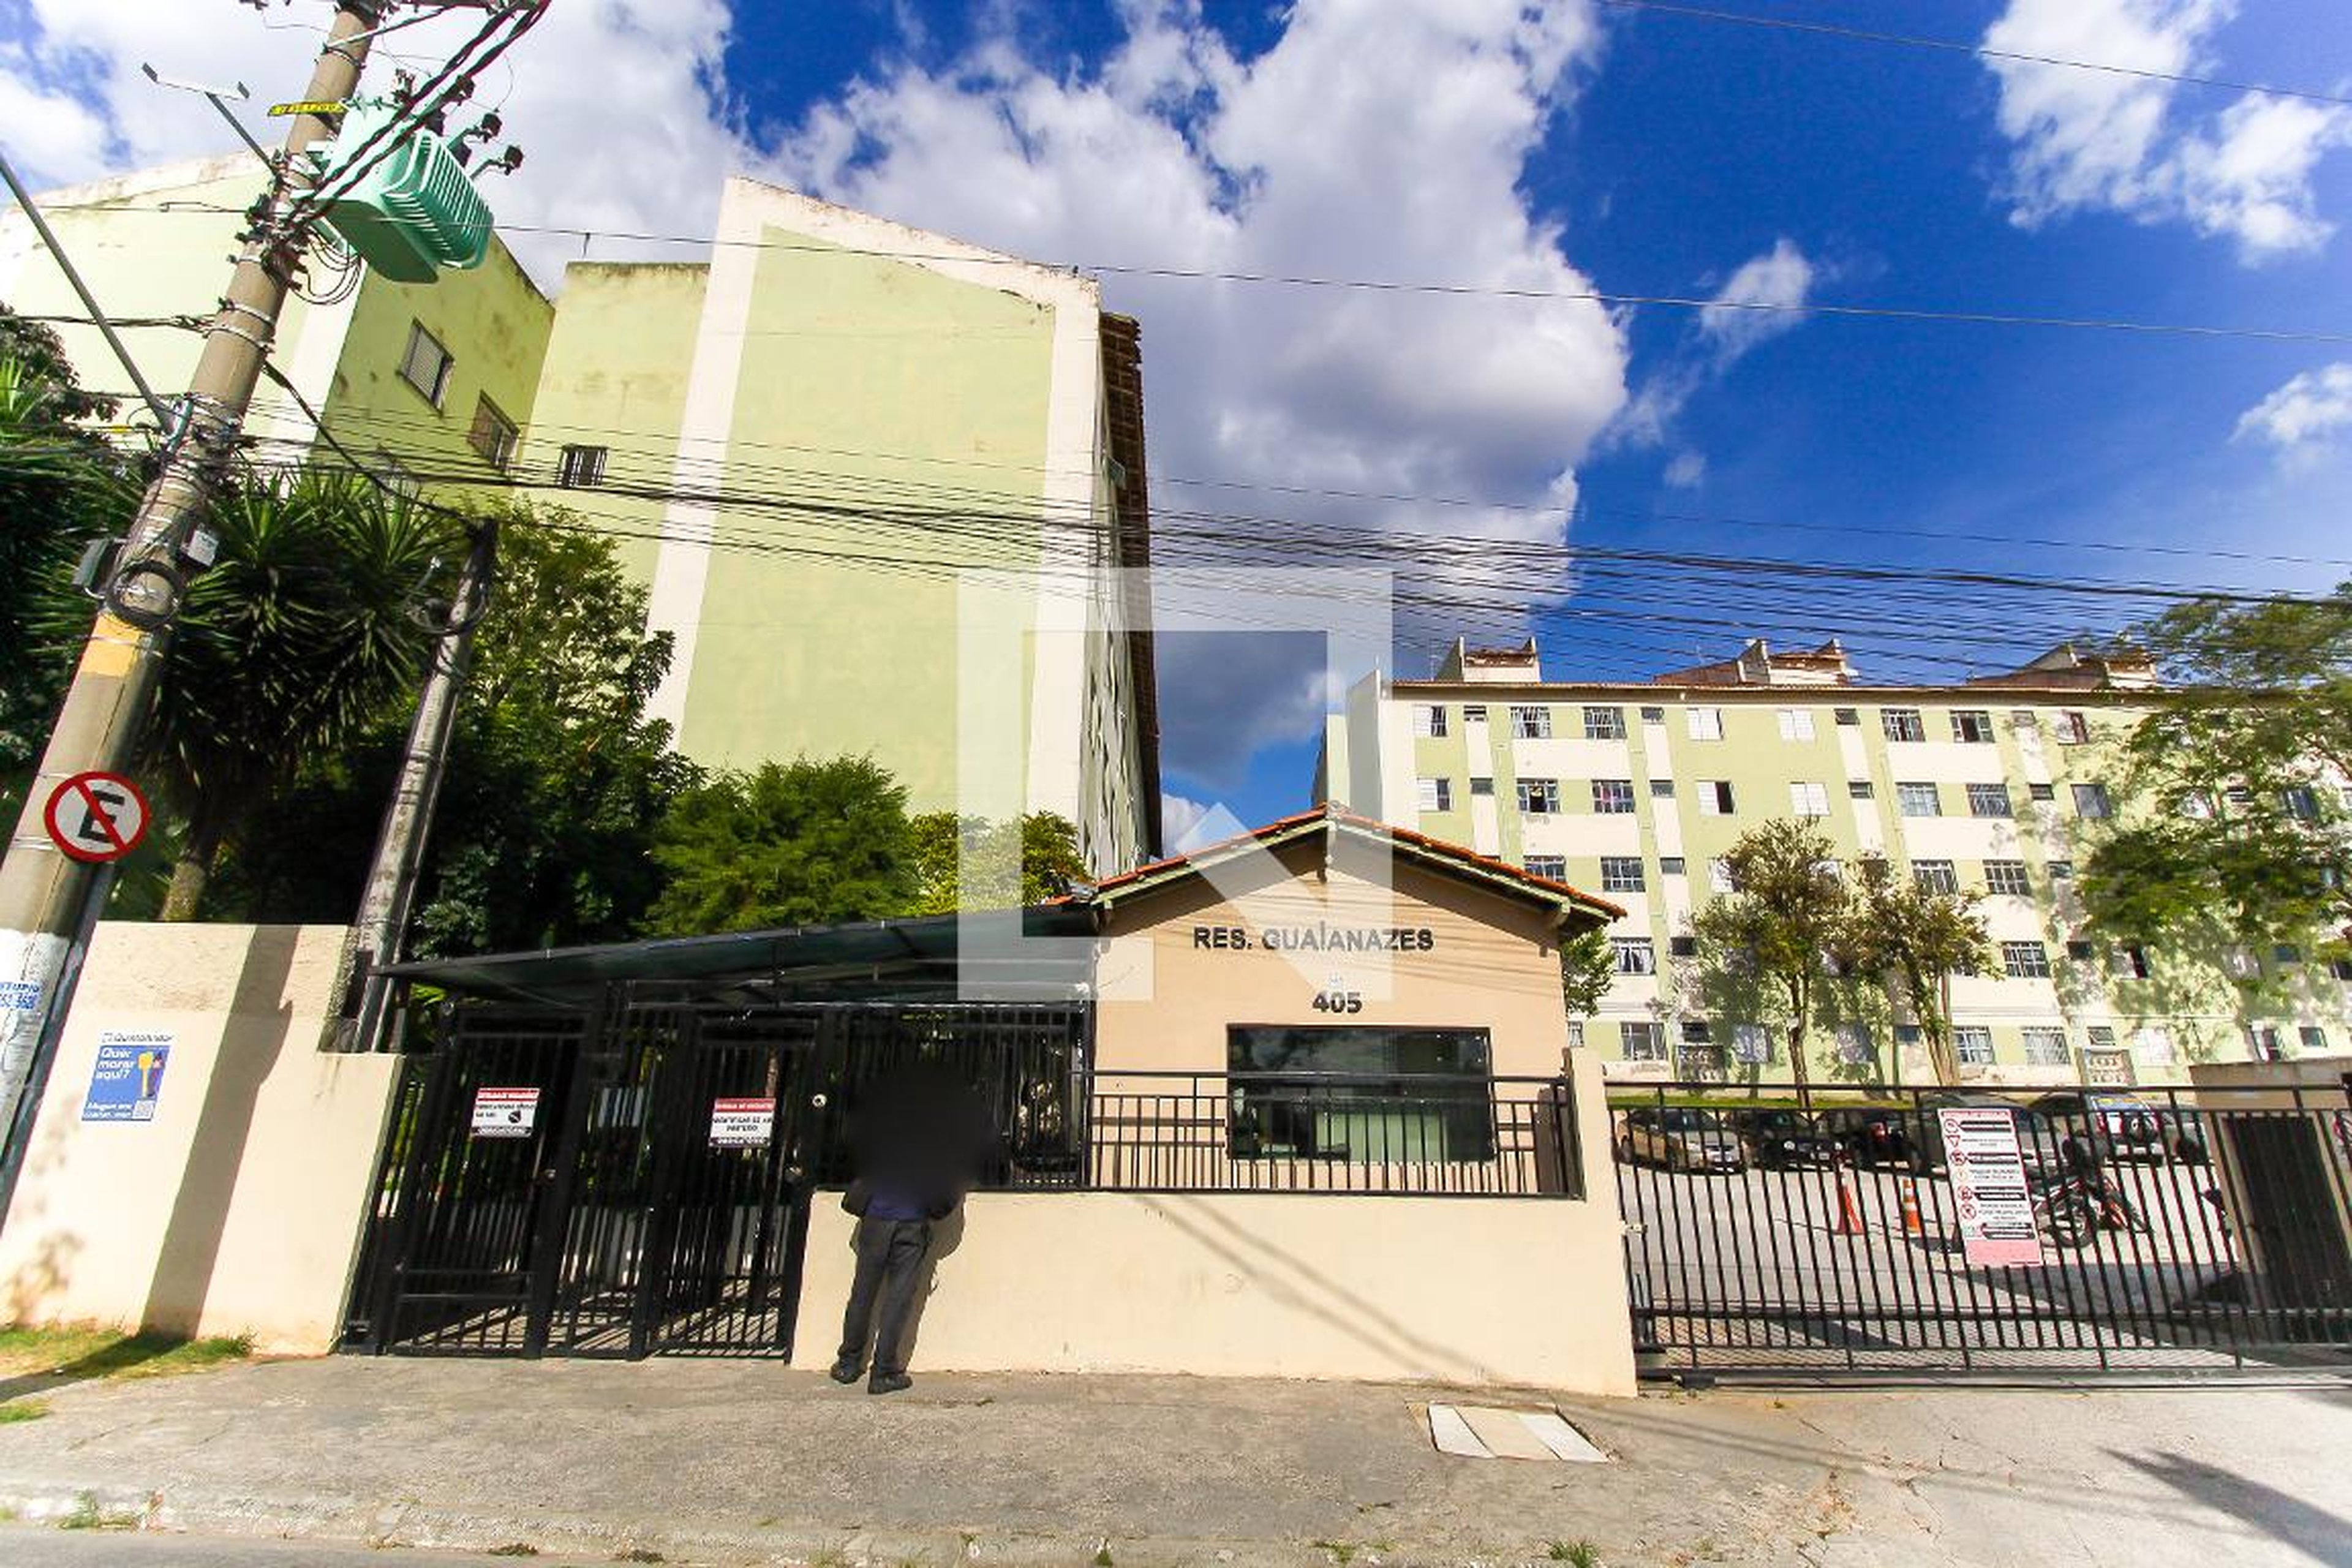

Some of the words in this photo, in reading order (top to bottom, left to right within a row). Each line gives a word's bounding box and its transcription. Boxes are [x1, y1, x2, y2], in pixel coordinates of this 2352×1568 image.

[78, 790, 125, 843] E
[1193, 927, 1253, 951] RES.
[1312, 992, 1363, 1014] 405
[97, 1060, 134, 1069] morar
